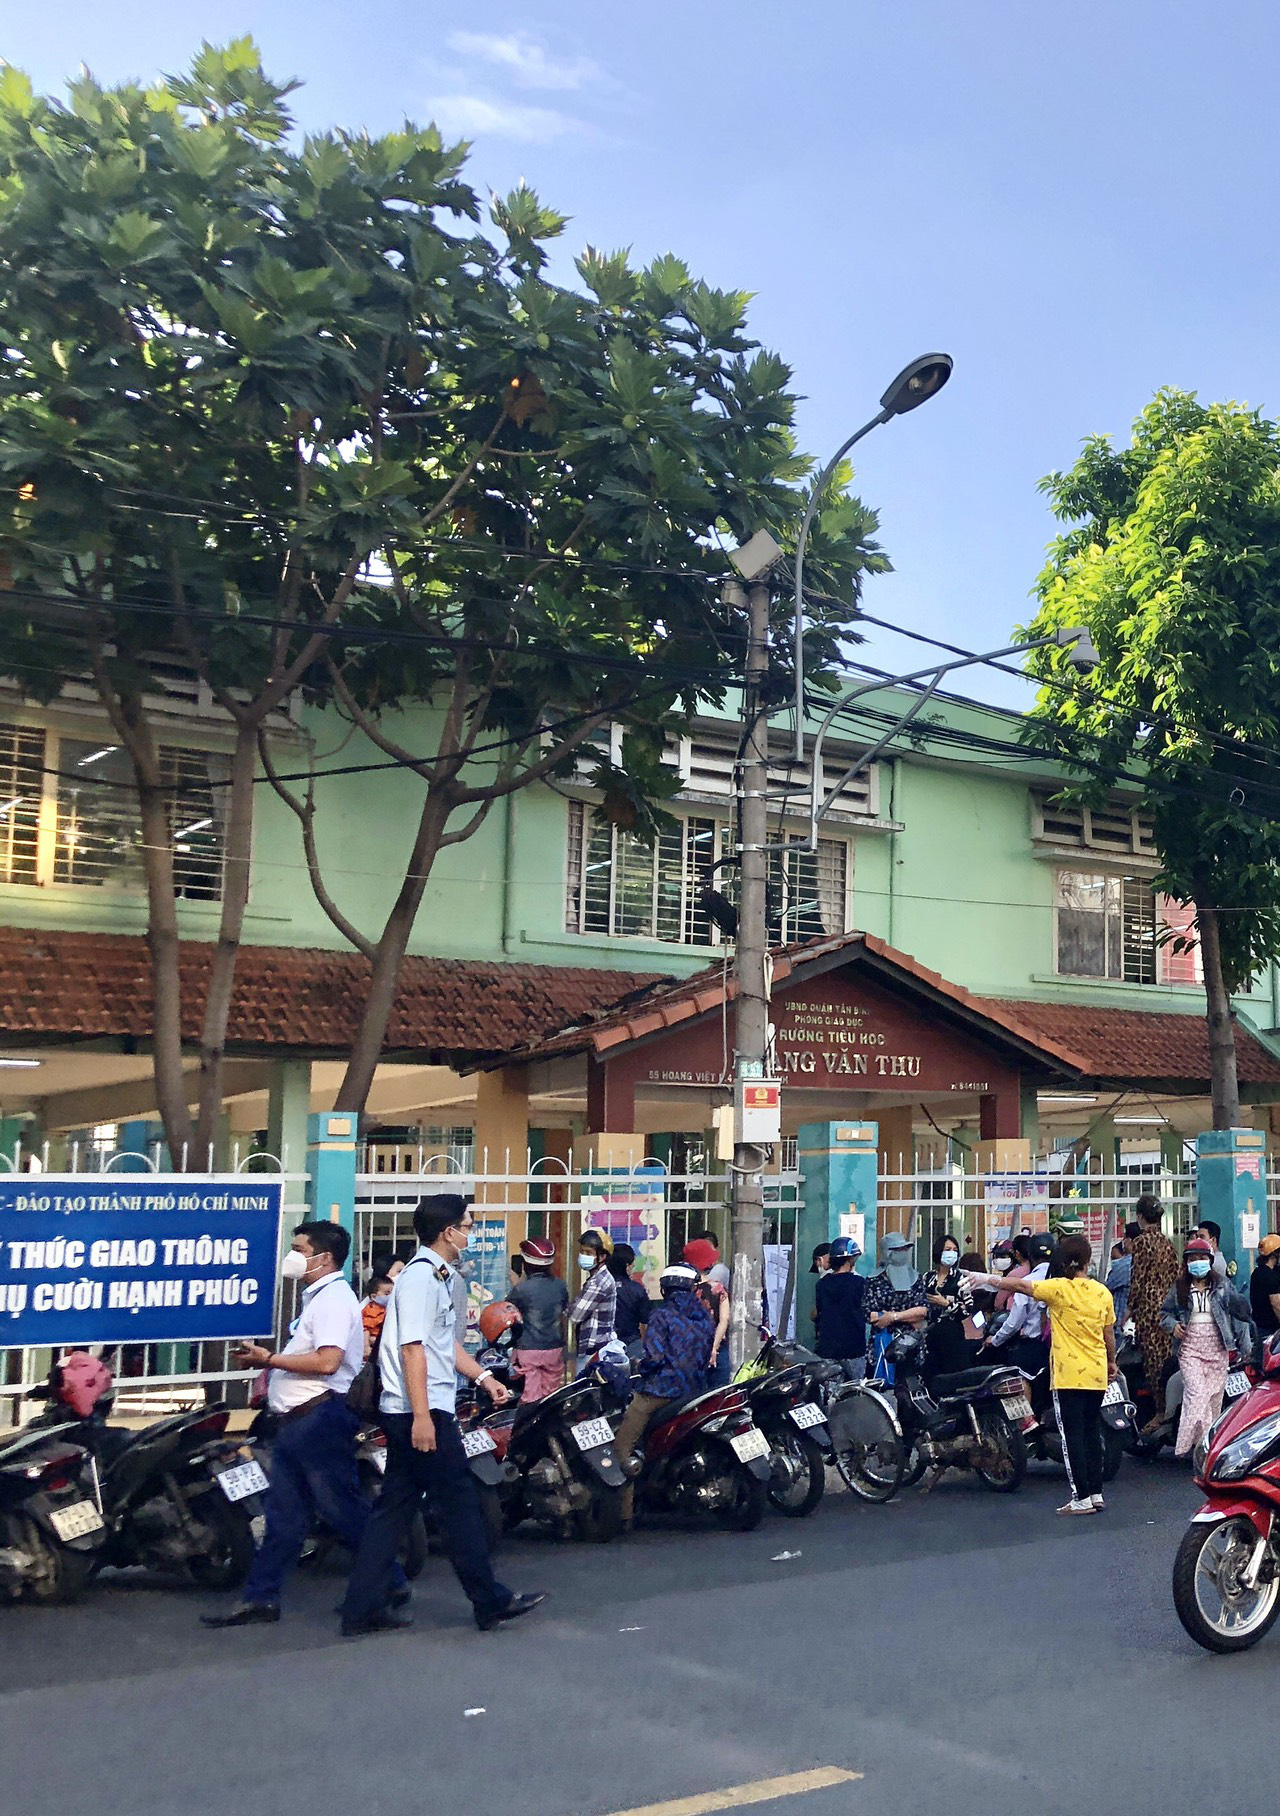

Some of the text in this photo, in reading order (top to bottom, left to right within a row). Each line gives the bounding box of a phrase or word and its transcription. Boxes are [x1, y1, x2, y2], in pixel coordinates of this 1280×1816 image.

[779, 1027, 824, 1043] RƯỜNG
[822, 1047, 869, 1075] VĂN
[53, 1196, 87, 1215] TẠO
[202, 1192, 229, 1210] CHÍ
[231, 1196, 269, 1211] MINH
[7, 1235, 85, 1269] THỨC
[90, 1239, 156, 1267] GIAO
[161, 1234, 249, 1266] THÔNG
[33, 1277, 104, 1312] CƯỜI
[108, 1280, 183, 1314] HẠNH
[187, 1274, 259, 1306] PHÚC
